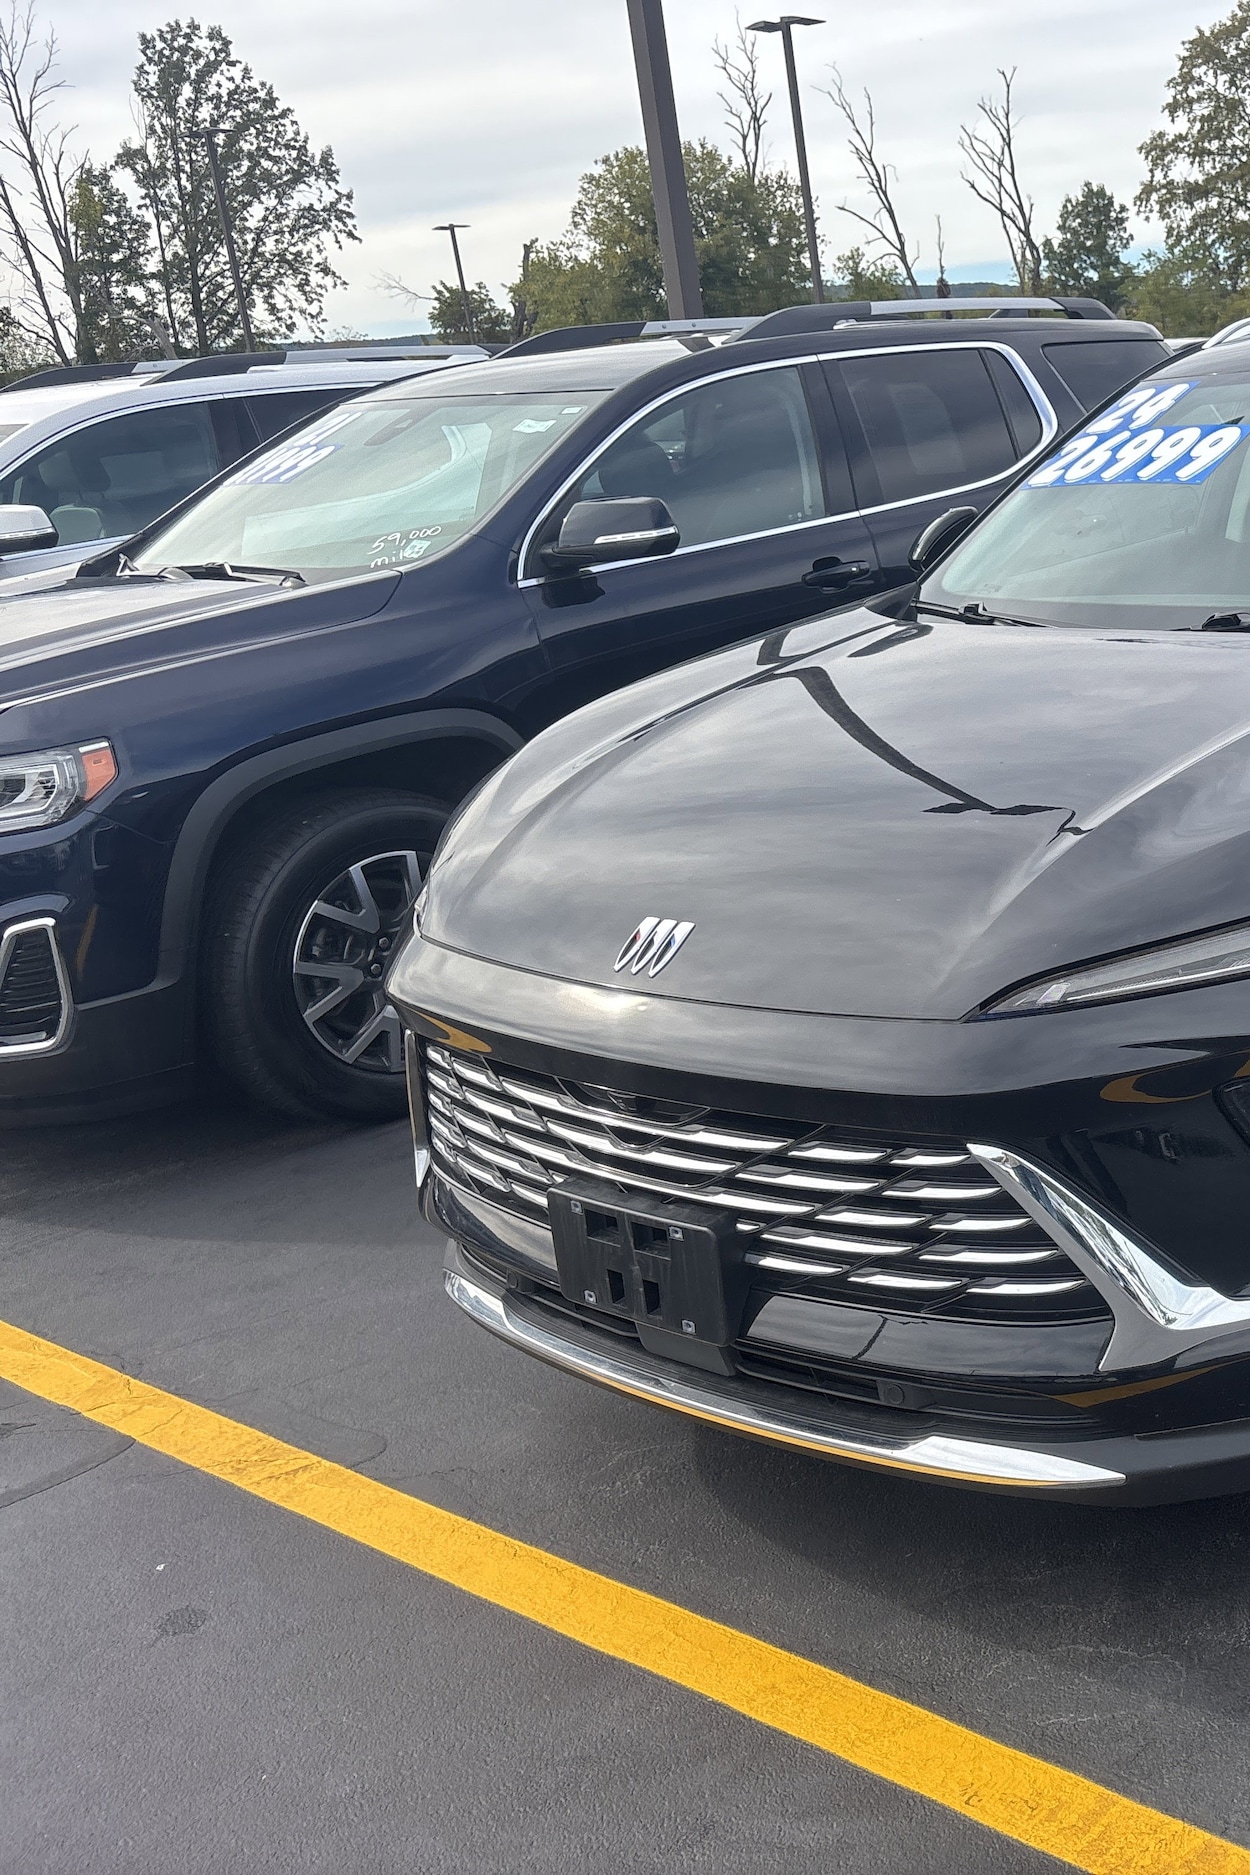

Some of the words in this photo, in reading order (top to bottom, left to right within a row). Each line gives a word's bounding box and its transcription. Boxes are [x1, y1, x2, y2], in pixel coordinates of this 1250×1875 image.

[1086, 383, 1190, 434] 24
[1027, 426, 1242, 487] 26999
[366, 526, 442, 554] 59,000
